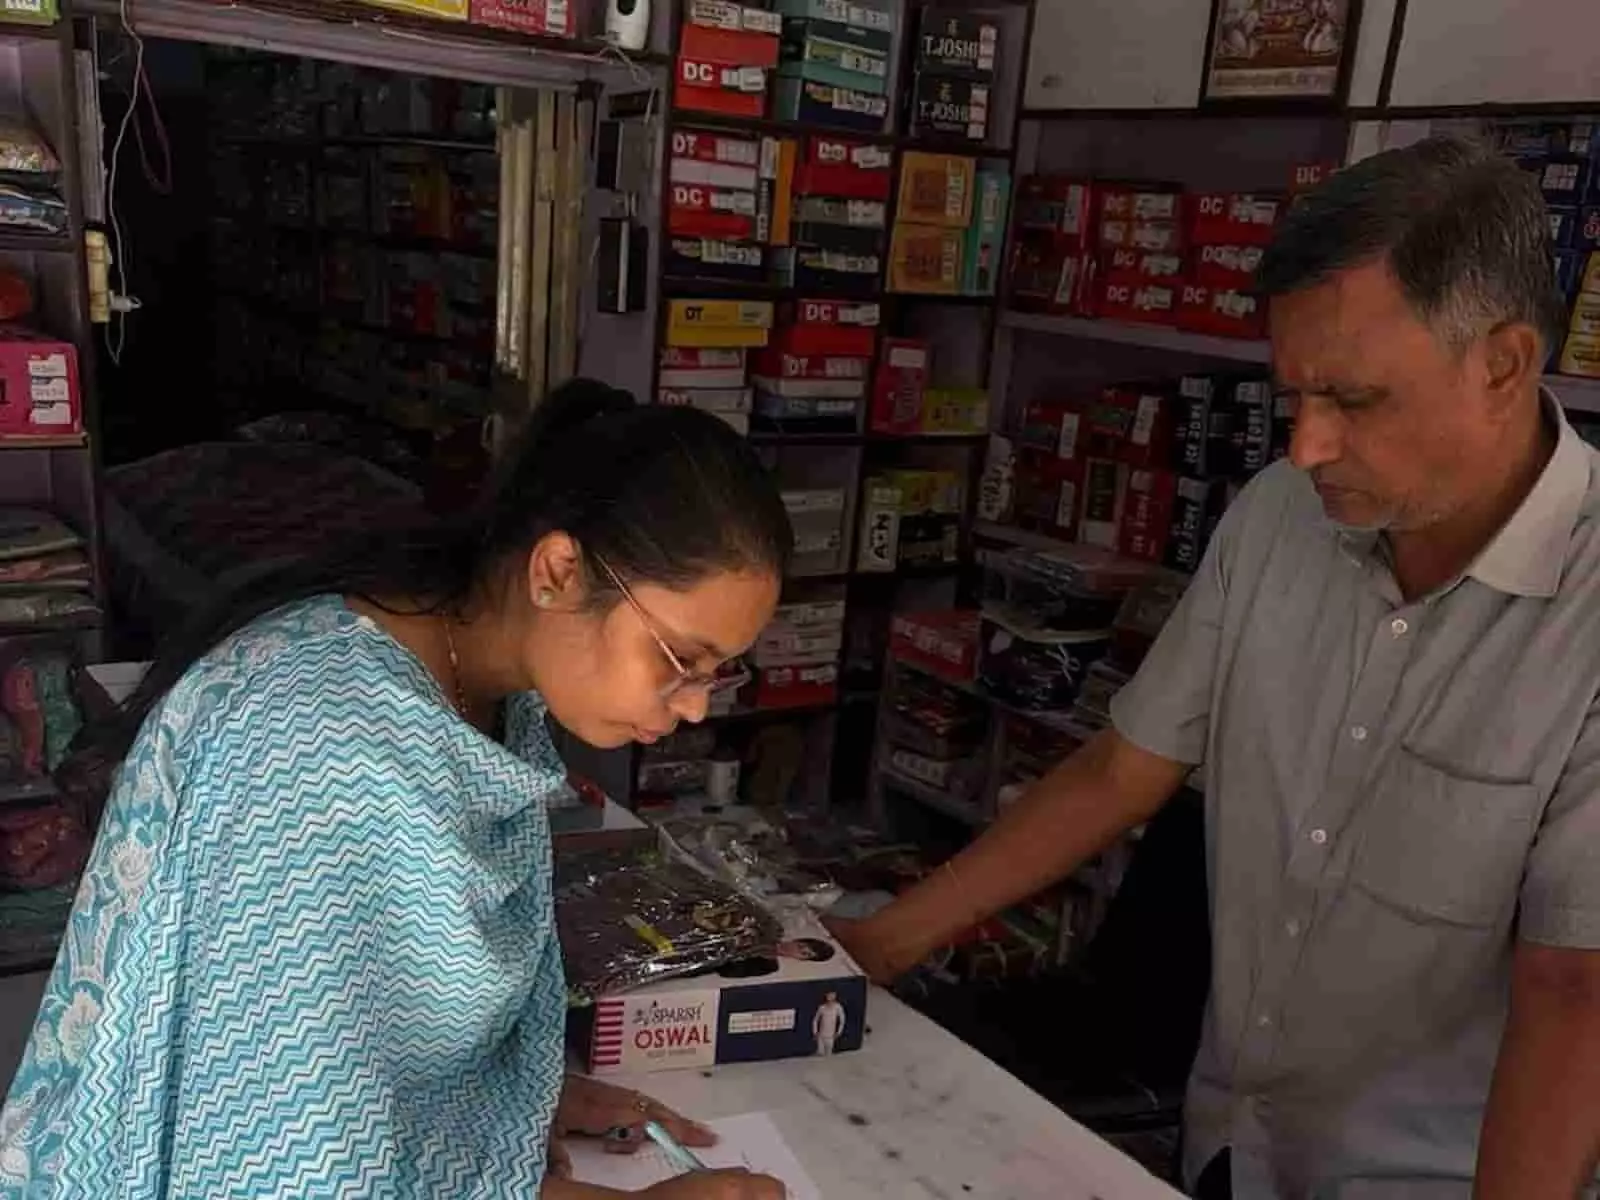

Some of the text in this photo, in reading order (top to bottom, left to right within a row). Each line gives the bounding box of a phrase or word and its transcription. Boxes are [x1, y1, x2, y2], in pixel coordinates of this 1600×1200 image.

[682, 61, 714, 82] DC
[673, 187, 704, 205] DC
[1200, 196, 1224, 216] DC
[1106, 285, 1129, 303] DC
[805, 303, 833, 321] DC
[634, 1024, 711, 1049] OSWAL
